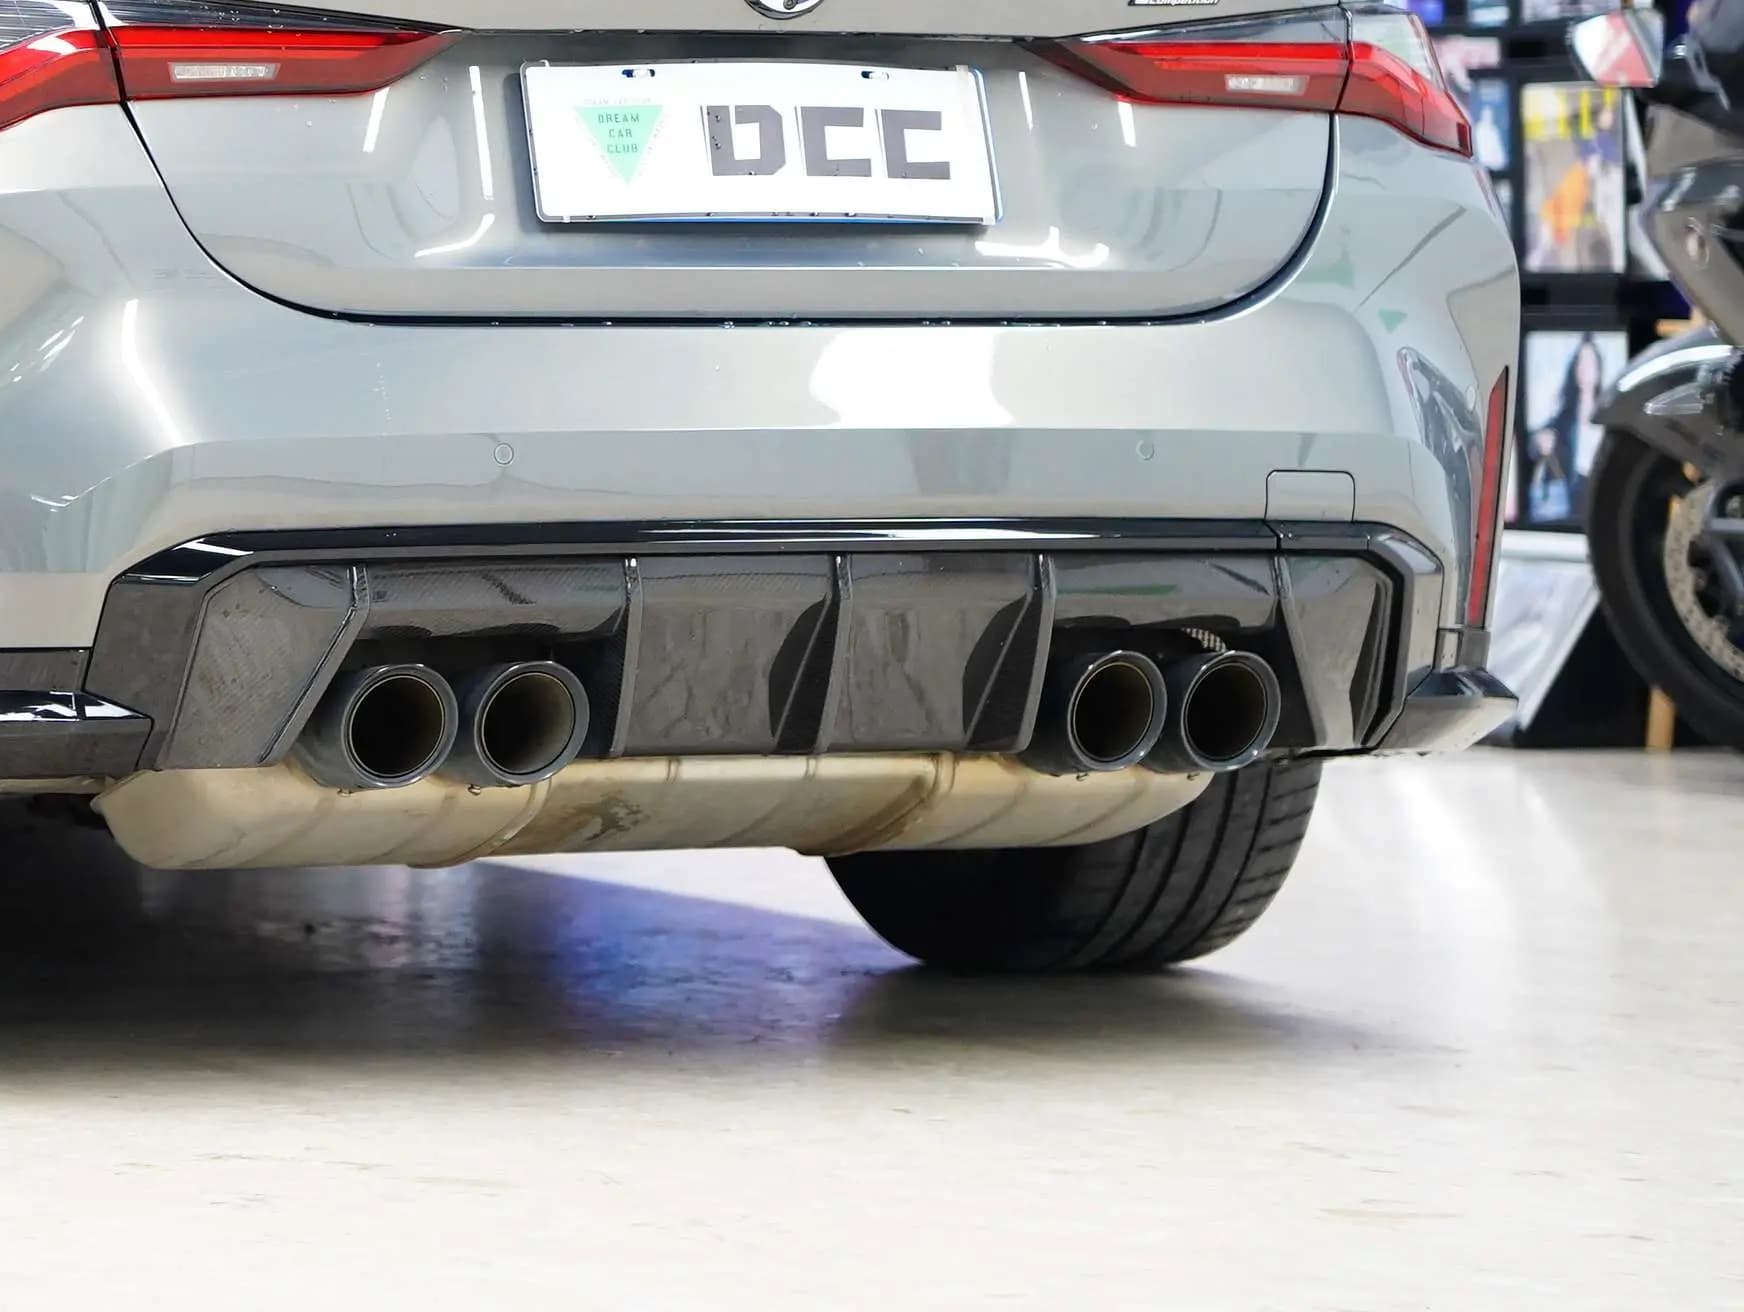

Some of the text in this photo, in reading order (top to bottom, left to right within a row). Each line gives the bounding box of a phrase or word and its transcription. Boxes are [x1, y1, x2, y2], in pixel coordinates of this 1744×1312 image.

[597, 112, 641, 125] DREAM
[608, 128, 633, 139] CAR
[606, 142, 640, 155] CLUB
[700, 104, 952, 181] DCC
